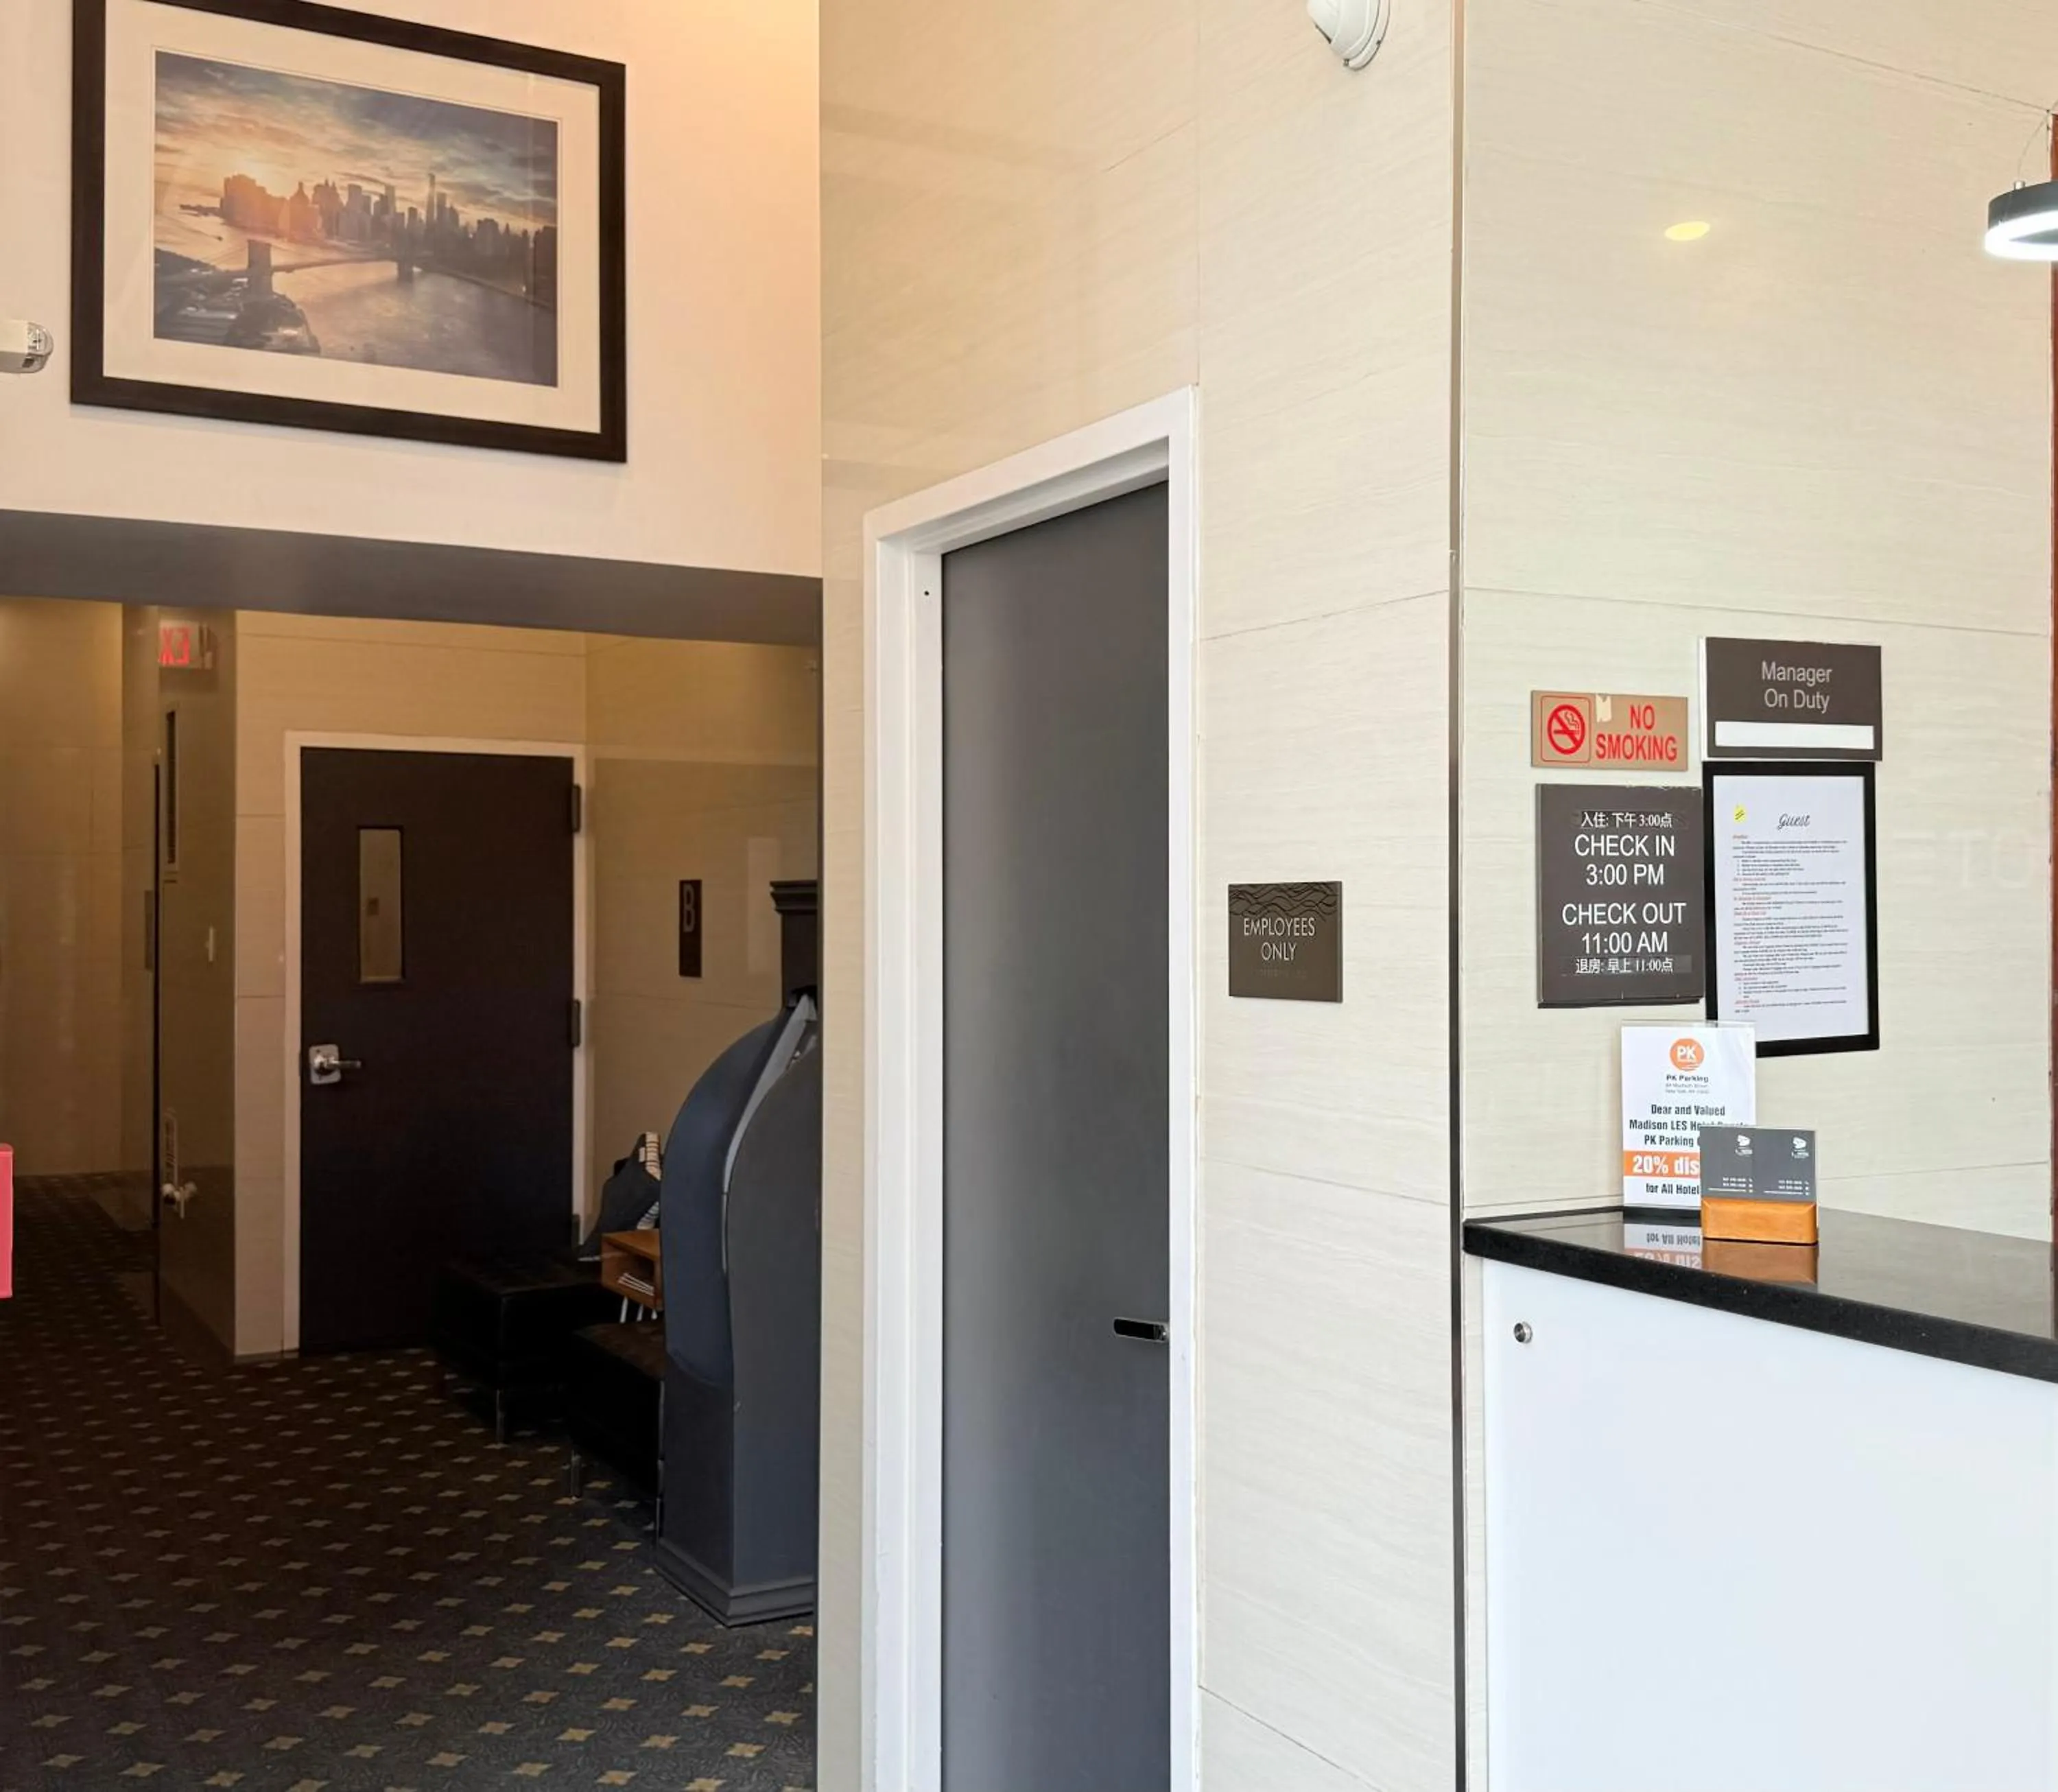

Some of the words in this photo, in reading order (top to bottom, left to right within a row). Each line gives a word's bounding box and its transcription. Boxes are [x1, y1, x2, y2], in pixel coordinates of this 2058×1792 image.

[1761, 660, 1833, 687] Manager
[1764, 688, 1788, 707] On
[1793, 689, 1830, 714] Duty
[1629, 704, 1655, 731] NO
[1596, 733, 1677, 762] SMOKING
[1777, 813, 1810, 831] Guest
[1574, 834, 1649, 856] CHECK
[1655, 835, 1675, 857] IN
[1586, 864, 1627, 886] 3:00
[1633, 864, 1664, 885] PM
[683, 883, 696, 932] B
[1562, 903, 1637, 926] CHECK
[1642, 902, 1687, 924] OUT
[1243, 917, 1316, 936] EMPLOYEES
[1261, 942, 1297, 960] ONLY
[1582, 932, 1632, 954] 11:00
[1636, 931, 1668, 953] AM
[1677, 1045, 1697, 1062] PK
[1651, 1104, 1672, 1115] Dear
[1675, 1105, 1692, 1115] and
[1694, 1105, 1725, 1116] Valued
[1629, 1119, 1668, 1130] Madison
[1670, 1120, 1688, 1131] LES
[1644, 1134, 1657, 1145] PK
[1659, 1135, 1694, 1147] Parking
[1633, 1155, 1669, 1175] 20%
[1646, 1183, 1659, 1192] for
[1661, 1183, 1673, 1194] All
[1676, 1184, 1699, 1194] Hotel
